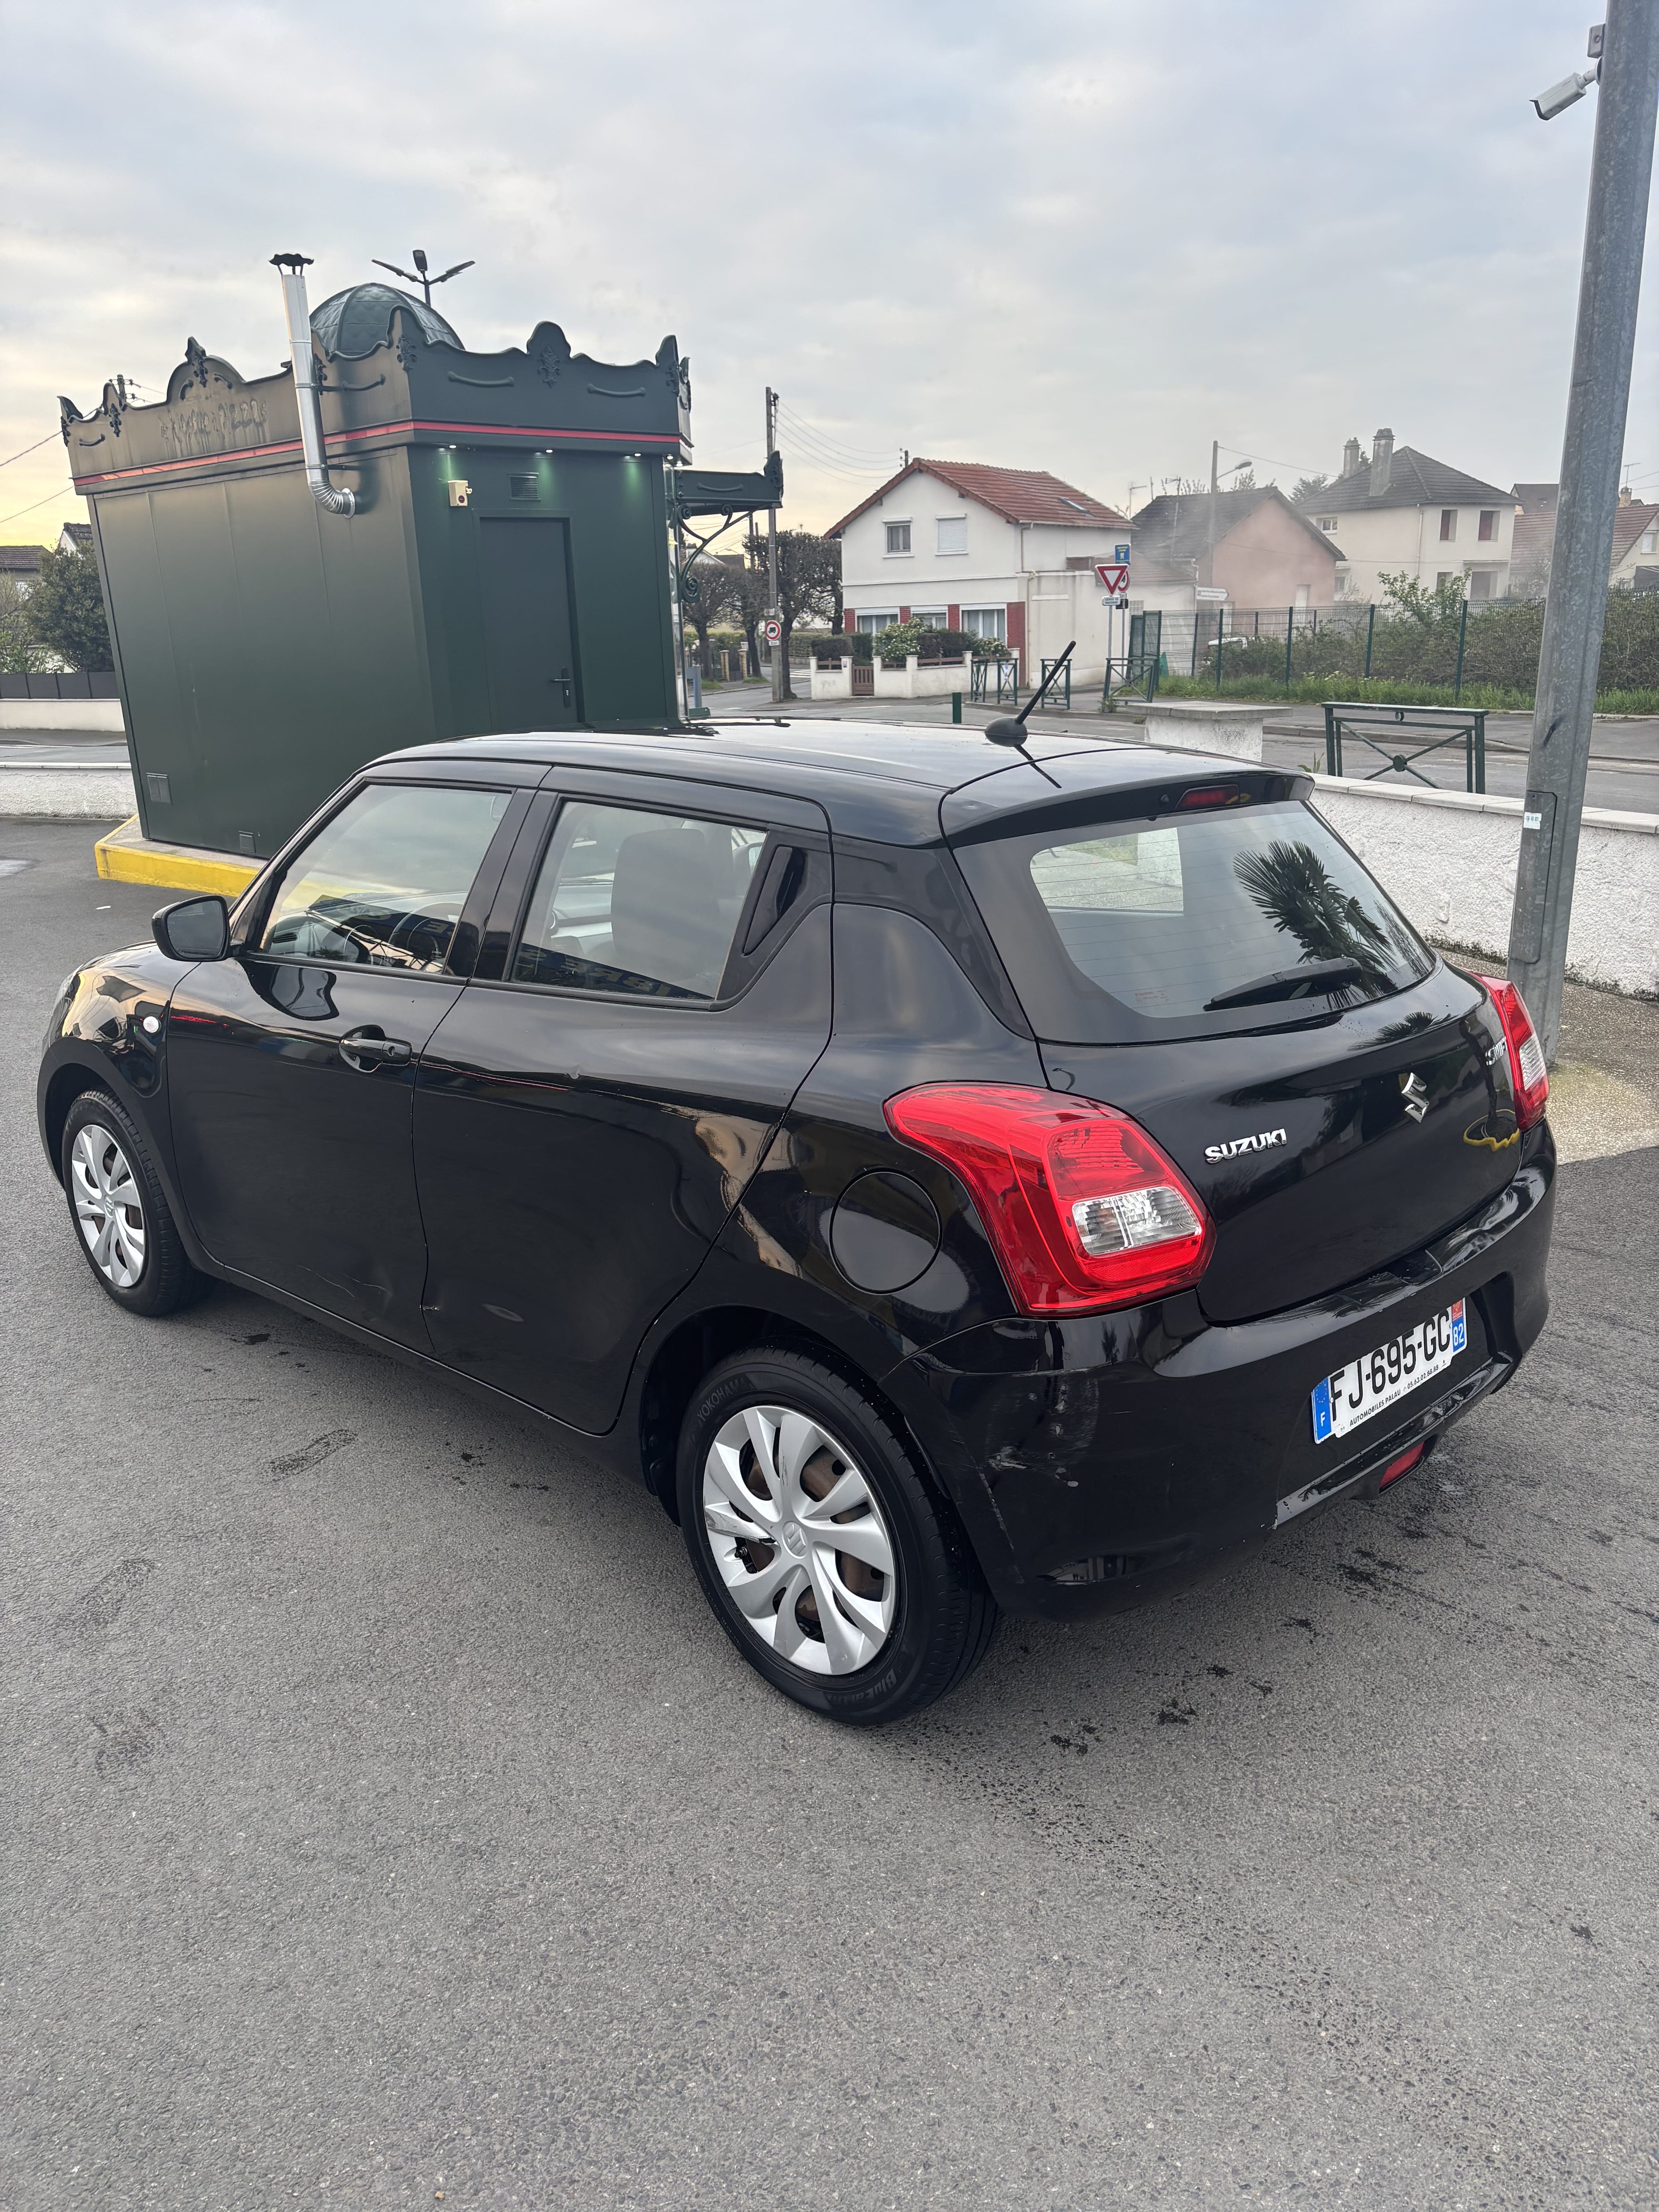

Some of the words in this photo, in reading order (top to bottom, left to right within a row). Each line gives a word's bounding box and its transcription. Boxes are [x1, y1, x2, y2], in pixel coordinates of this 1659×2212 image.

[1205, 1128, 1286, 1163] SUZUKI
[1453, 1323, 1464, 1346] 82
[1330, 1308, 1450, 1422] FJ-695-GC
[697, 1377, 756, 1421] YOKOHAMA
[1350, 1400, 1384, 1427] AUTOMOBILES
[1385, 1389, 1401, 1404] PALAU
[1321, 1412, 1325, 1427] F
